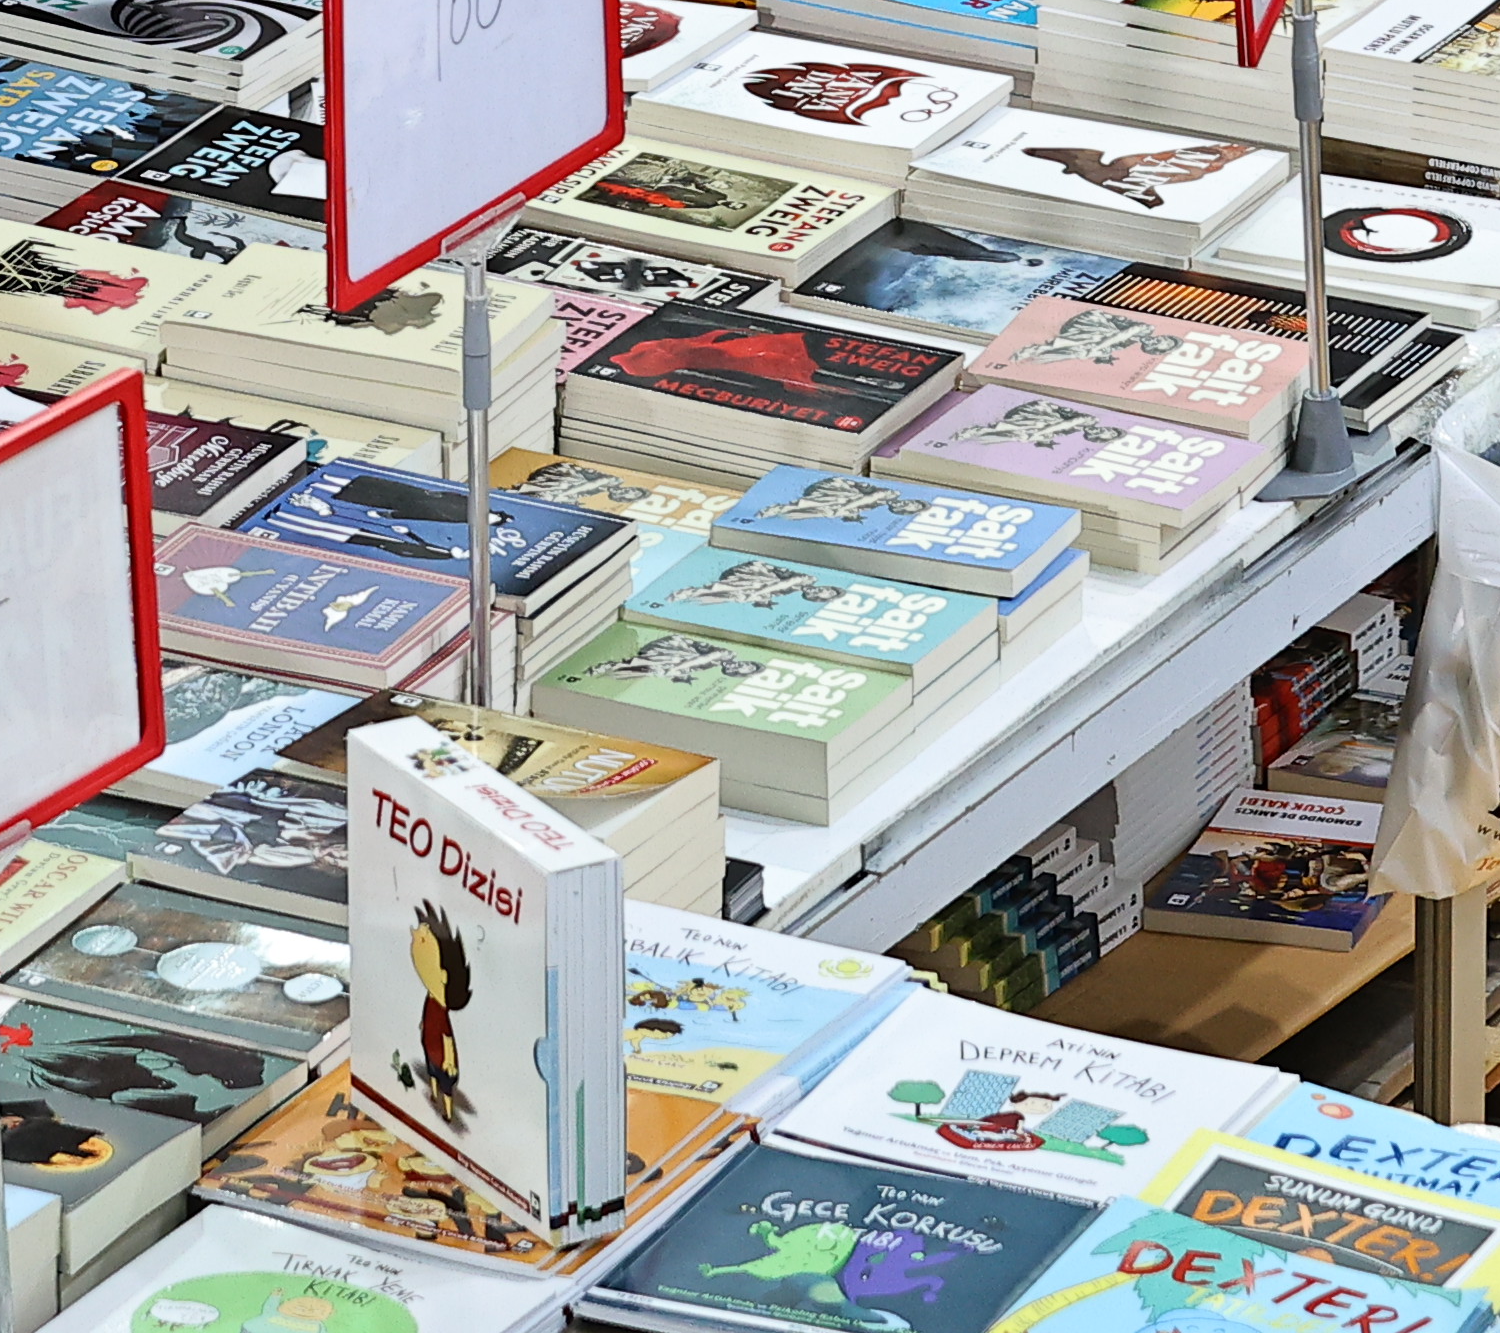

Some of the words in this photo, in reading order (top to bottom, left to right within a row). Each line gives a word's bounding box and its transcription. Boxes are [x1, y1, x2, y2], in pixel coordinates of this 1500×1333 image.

[1359, 31, 1398, 52] PRENS
[1380, 37, 1413, 55] WILDE
[1386, 14, 1422, 33] MUTLU
[1402, 23, 1434, 39] OSCAR
[797, 67, 889, 115] VANYA
[18, 86, 147, 161] STEFAN
[166, 120, 273, 179] ZWEIG
[199, 128, 300, 187] STEFAN
[1096, 142, 1221, 203] MARTI
[742, 185, 835, 238] ZWEIG
[775, 191, 865, 244] STEFAN
[822, 332, 937, 369] STEFAN
[824, 350, 921, 381] ZWEIG
[1131, 332, 1245, 397] faik
[1187, 341, 1290, 406] sait
[652, 376, 822, 426] MECBURİYET
[188, 447, 249, 483] GÜRPINAR
[222, 442, 276, 473] HÜSEYİN
[1069, 425, 1181, 482] faik
[1125, 437, 1231, 494] sait
[191, 471, 238, 496] RAHMİ
[540, 525, 595, 556] HÜSEYİN
[885, 496, 985, 551] faik
[949, 504, 1038, 560] sait
[506, 531, 568, 567] GÜRPINAR
[510, 554, 555, 579] RAHMİ
[234, 564, 353, 633] İNTİBAH
[347, 597, 403, 629] KEMAL
[366, 600, 422, 631] NAMIK
[791, 583, 902, 642] faik
[850, 593, 956, 653] sait
[708, 659, 821, 717] faik
[769, 668, 876, 728] sait
[214, 705, 307, 761] LONDON
[465, 780, 514, 825] Dizisi
[1233, 804, 1278, 820] AMICIS
[1240, 794, 1285, 813] KALBİ
[1280, 811, 1298, 822] DE
[1288, 798, 1343, 817] ÇOCUK
[1300, 813, 1361, 827] EDMONDO
[370, 786, 436, 863] TEO
[438, 834, 525, 928] Dizisi
[512, 812, 577, 856] TEO
[958, 1038, 1067, 1075] DEPREM
[1072, 1058, 1178, 1105] KİTABI
[876, 1182, 946, 1208] TEO'NUN
[1264, 1172, 1364, 1215] SUNUM
[1361, 1195, 1446, 1236] GÜNÜ
[760, 1190, 852, 1227] GECE
[863, 1202, 1002, 1254] KORKUSU
[817, 1219, 904, 1254] KİTABI
[1193, 1187, 1473, 1282] DEXTER!
[305, 1275, 380, 1310] KİTABI
